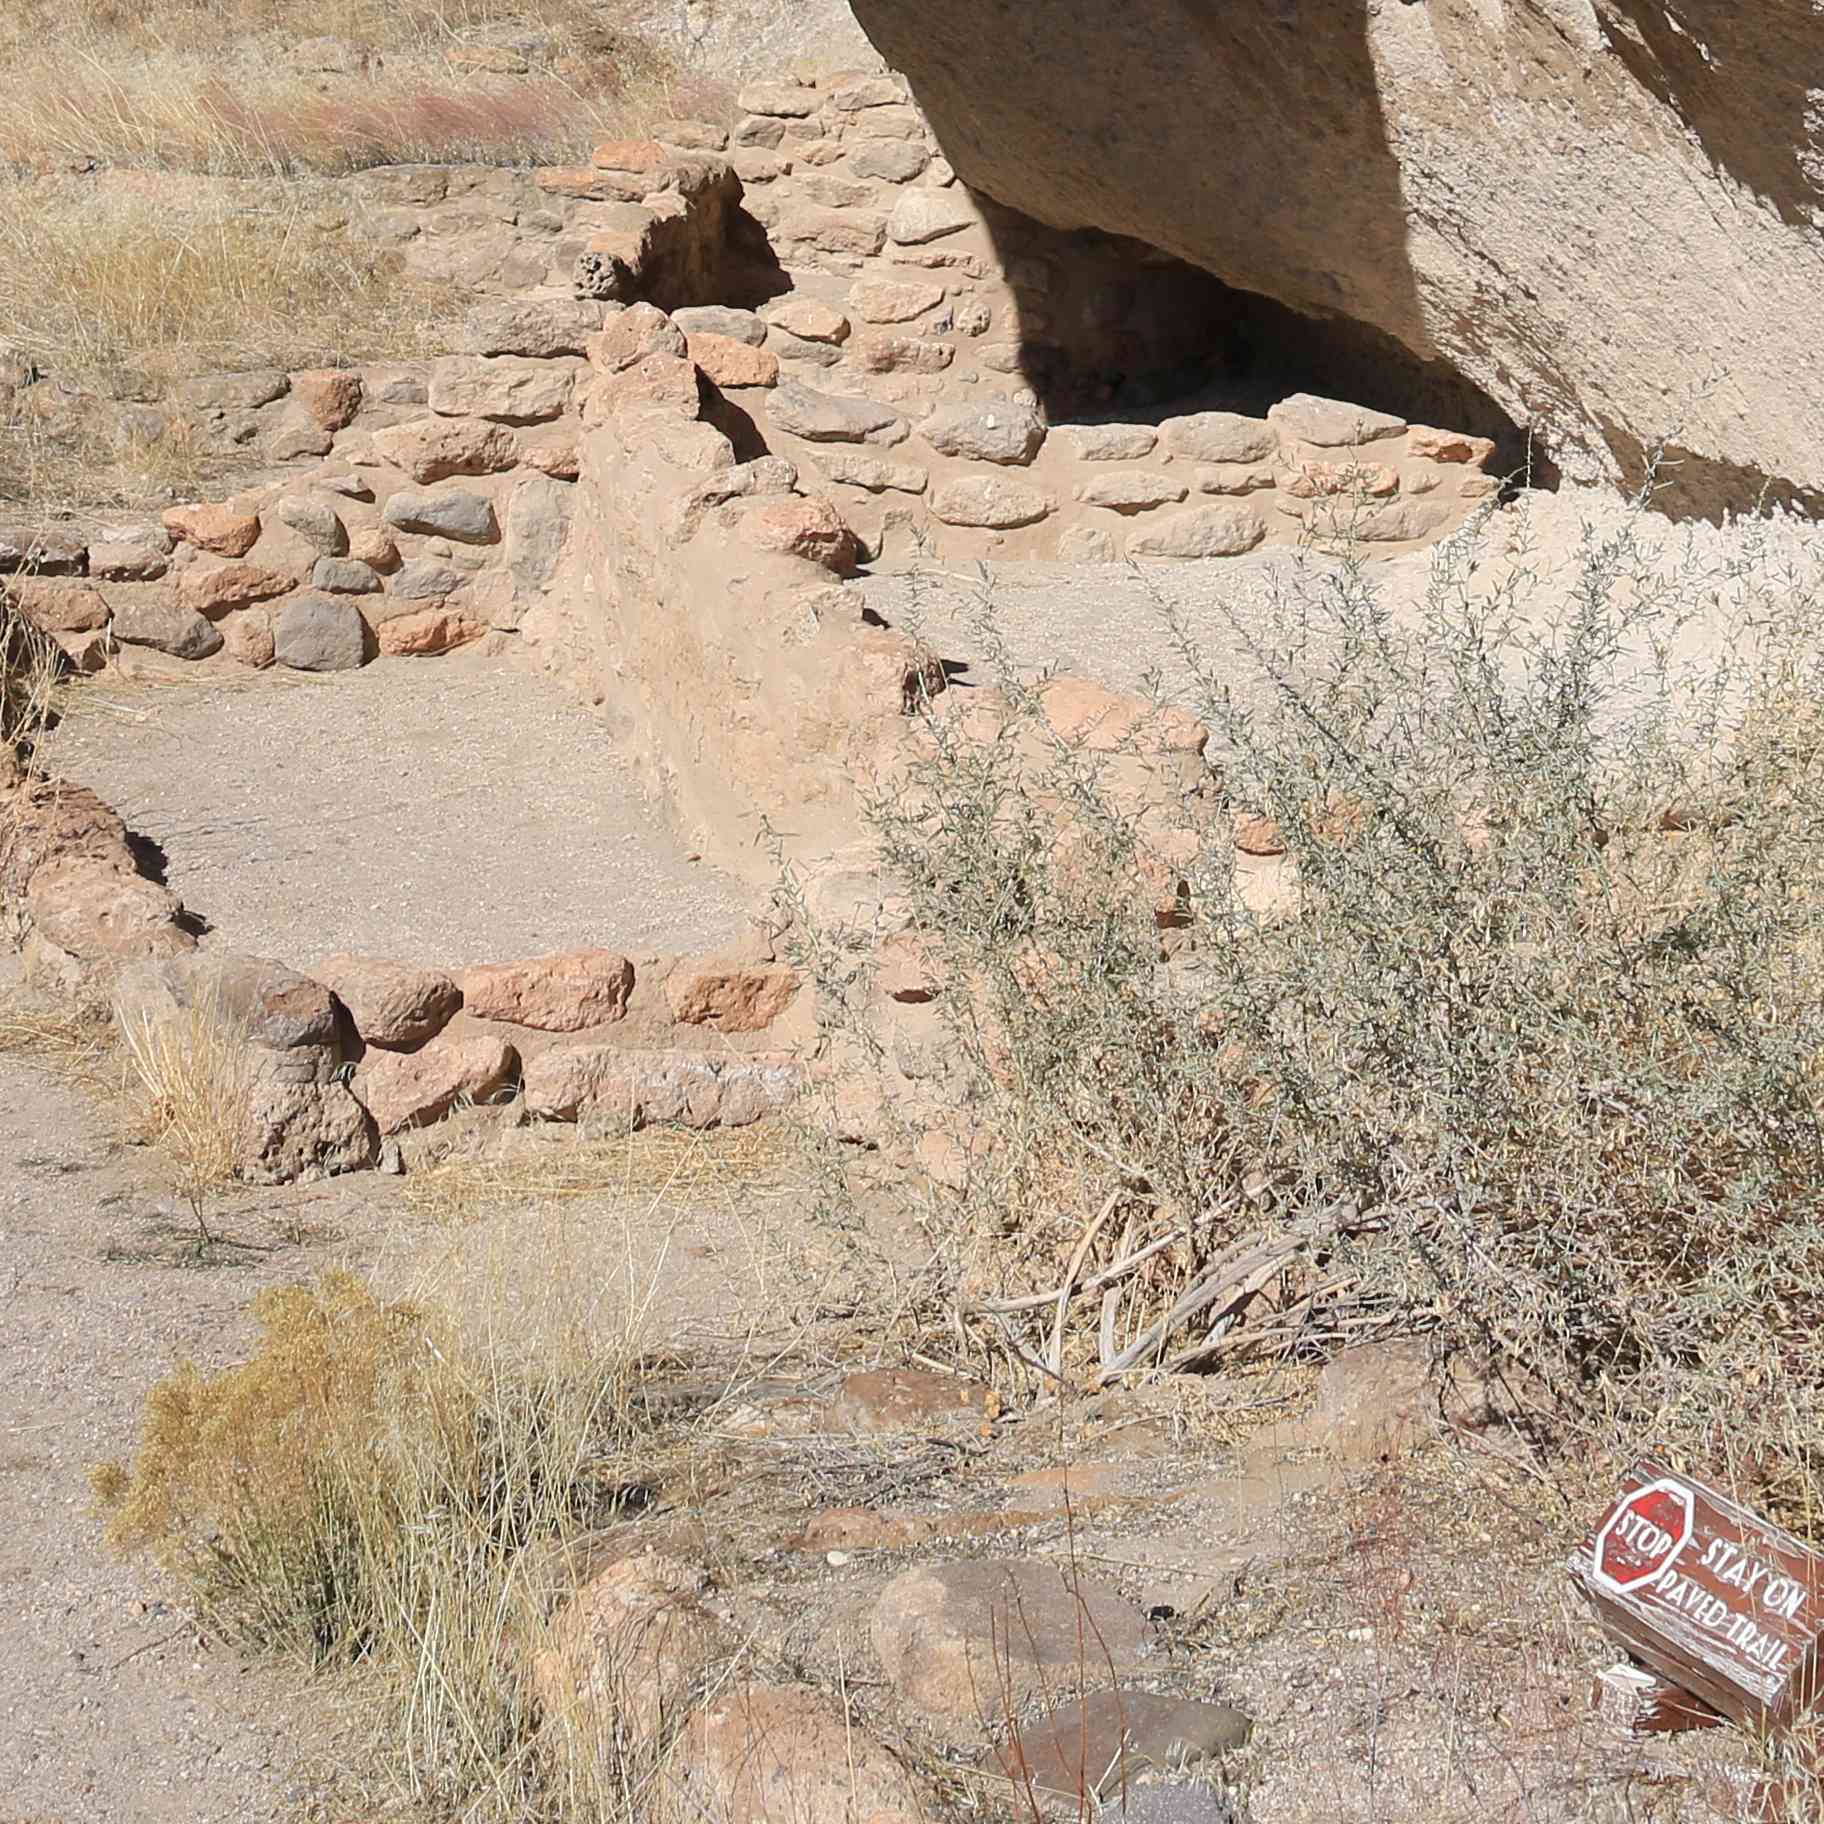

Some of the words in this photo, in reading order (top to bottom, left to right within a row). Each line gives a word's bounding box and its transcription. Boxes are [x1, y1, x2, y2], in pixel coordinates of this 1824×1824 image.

[1615, 1509, 1673, 1559] STOP
[1701, 1537, 1767, 1592] STAY
[1763, 1579, 1806, 1619] ON
[1656, 1569, 1728, 1627] PAVED
[1726, 1613, 1790, 1670] TRAIL
